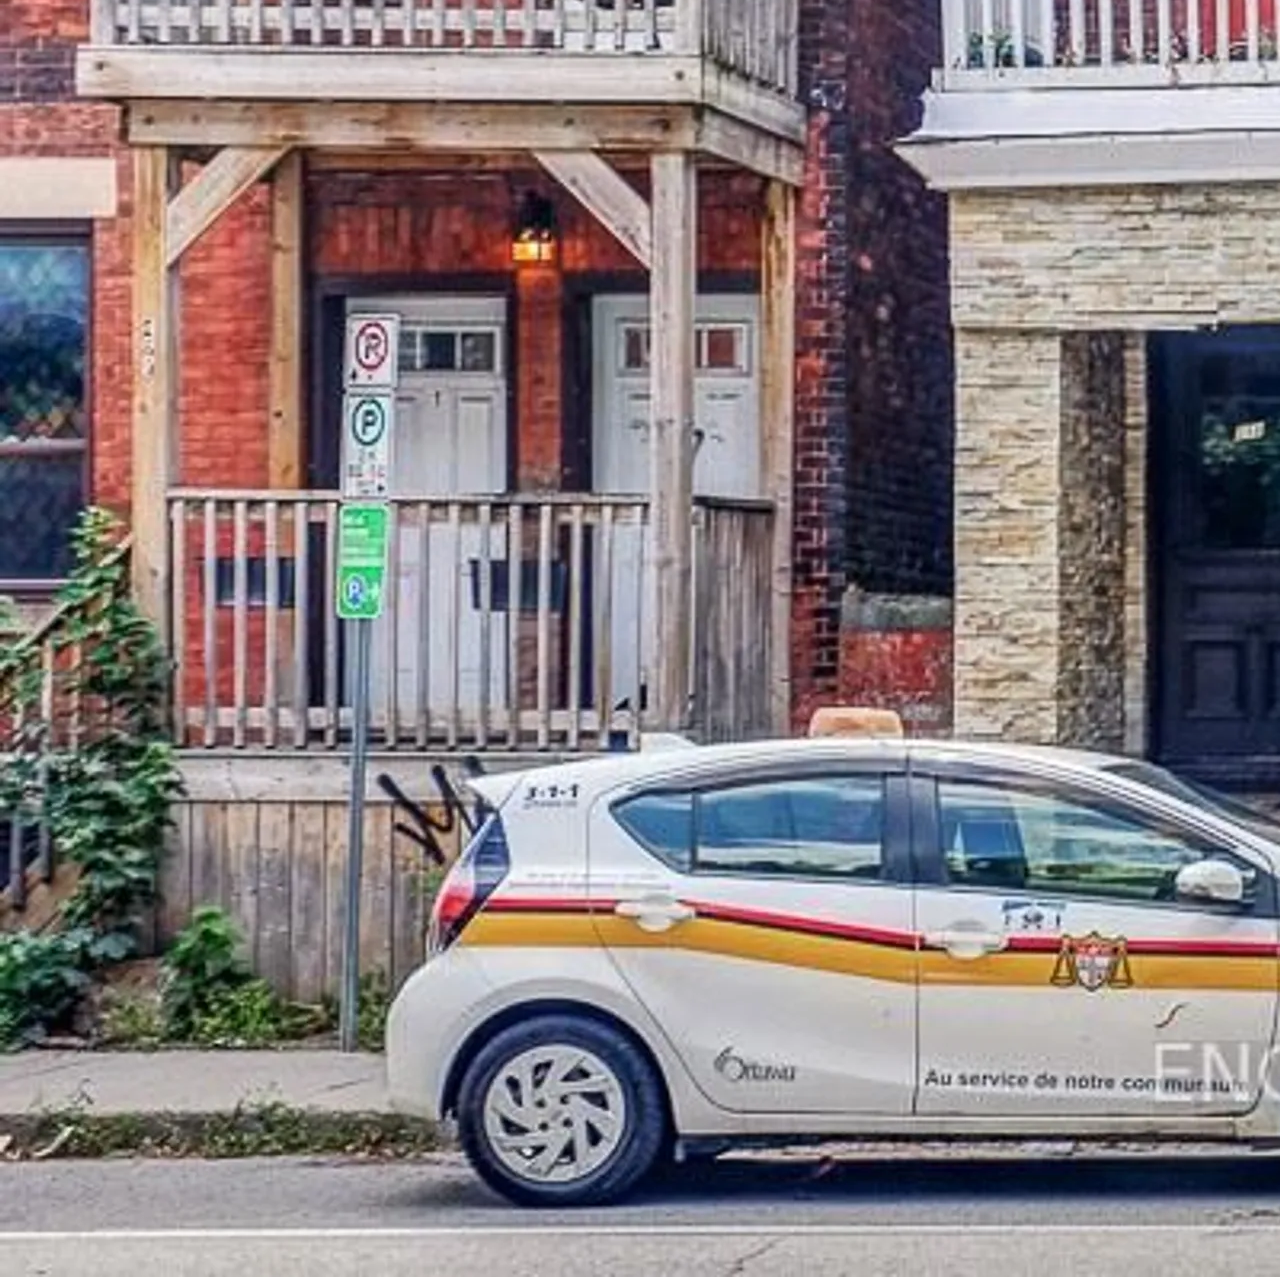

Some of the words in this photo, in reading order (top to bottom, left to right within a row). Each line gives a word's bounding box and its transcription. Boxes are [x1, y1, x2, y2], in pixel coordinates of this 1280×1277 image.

[924, 1070, 951, 1086] Au
[958, 1071, 1029, 1089] service
[1034, 1071, 1059, 1090] de
[1065, 1073, 1115, 1091] notre
